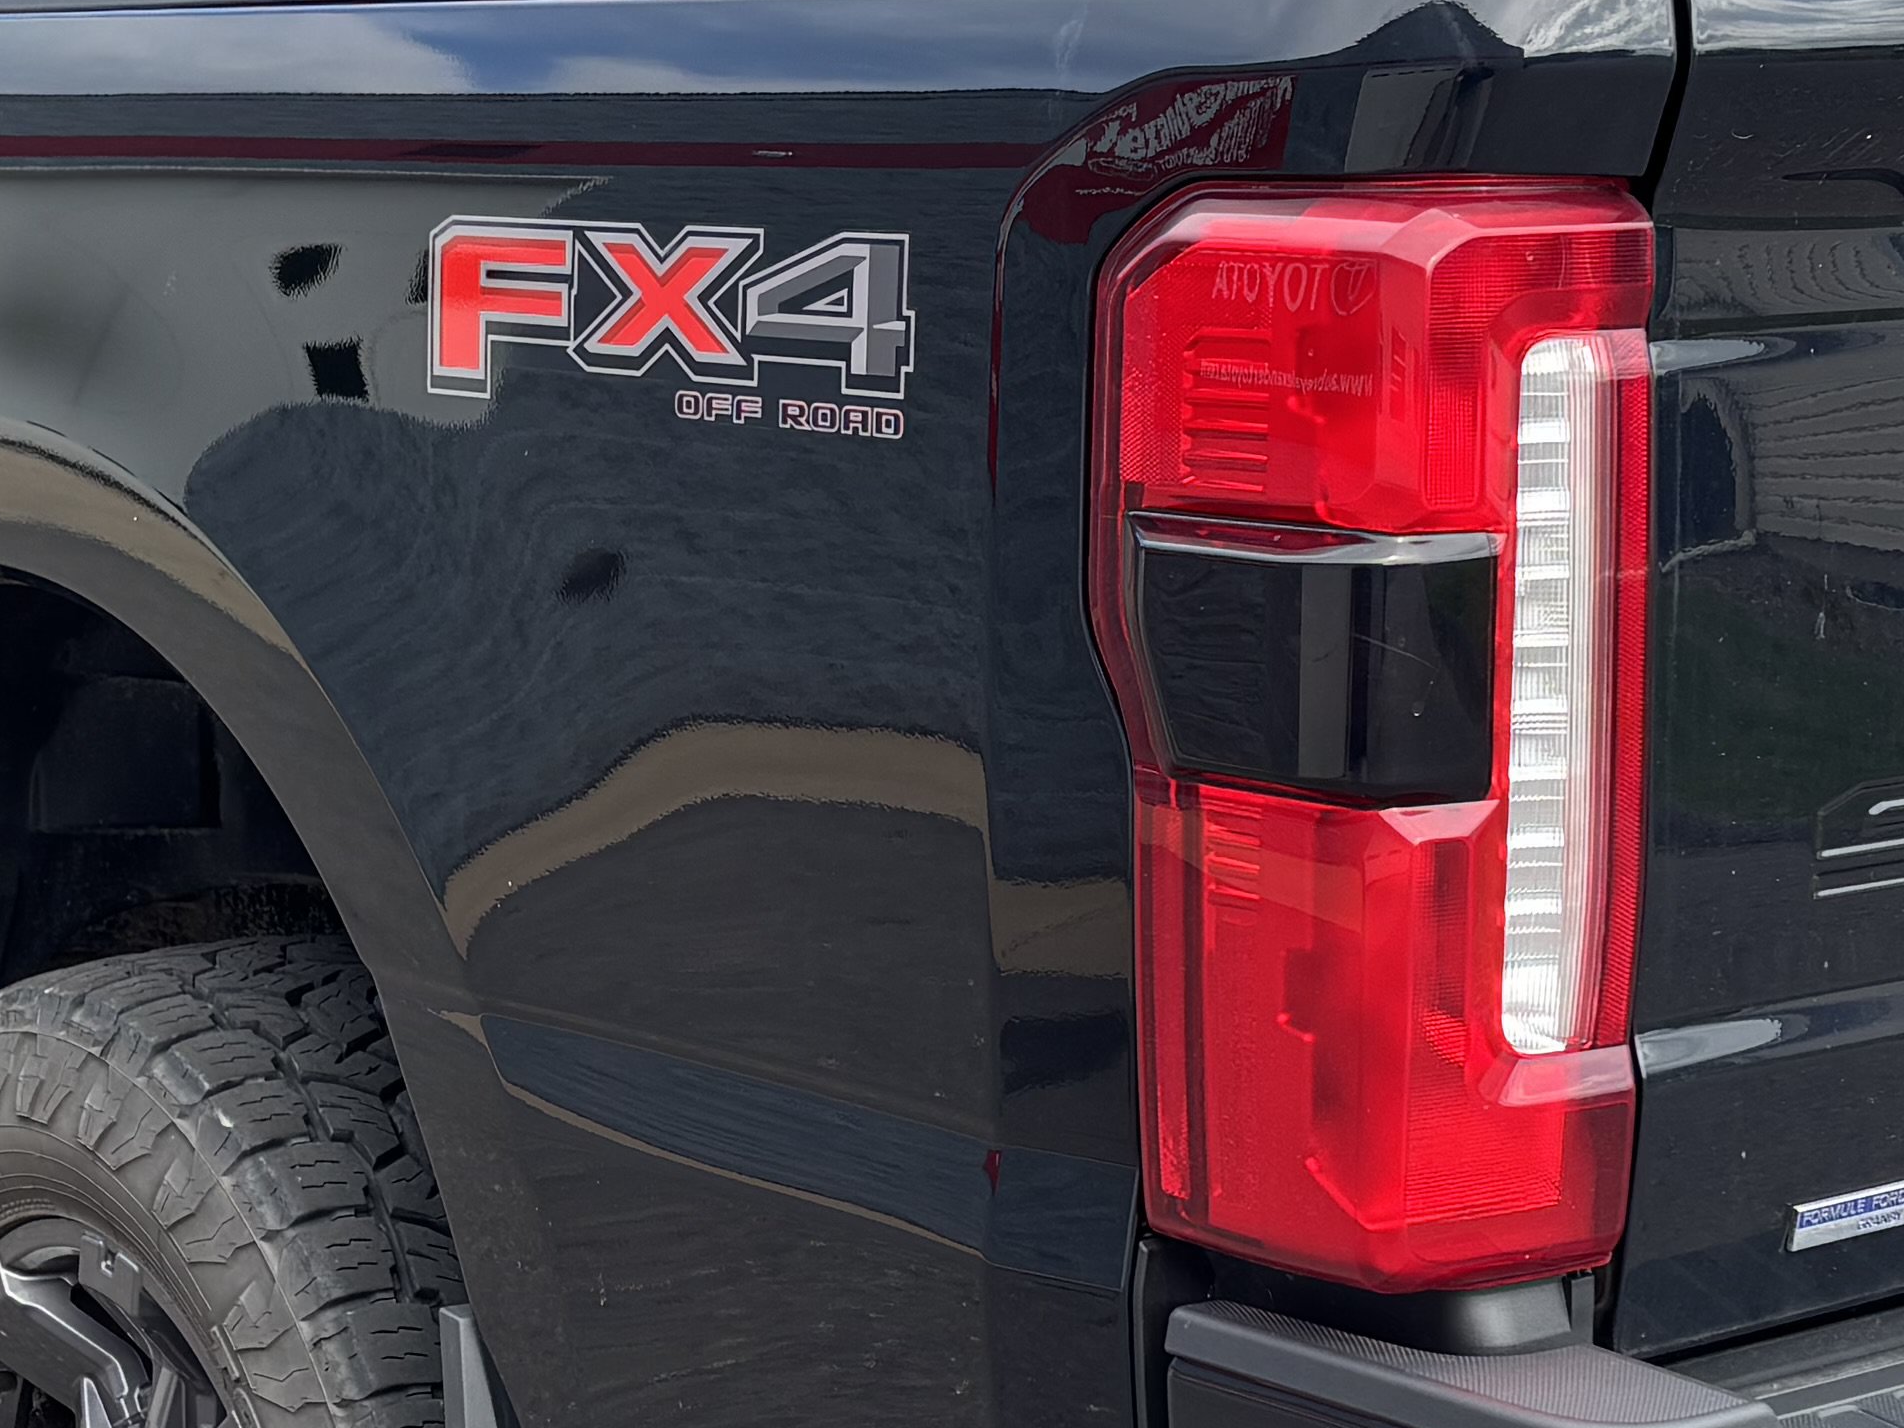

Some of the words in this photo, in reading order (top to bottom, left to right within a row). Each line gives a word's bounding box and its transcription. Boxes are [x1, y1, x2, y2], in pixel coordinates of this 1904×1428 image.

[427, 215, 916, 399] FX4
[674, 390, 763, 425] OFF
[778, 400, 905, 440] ROAD
[1802, 1198, 1866, 1227] FORMULE
